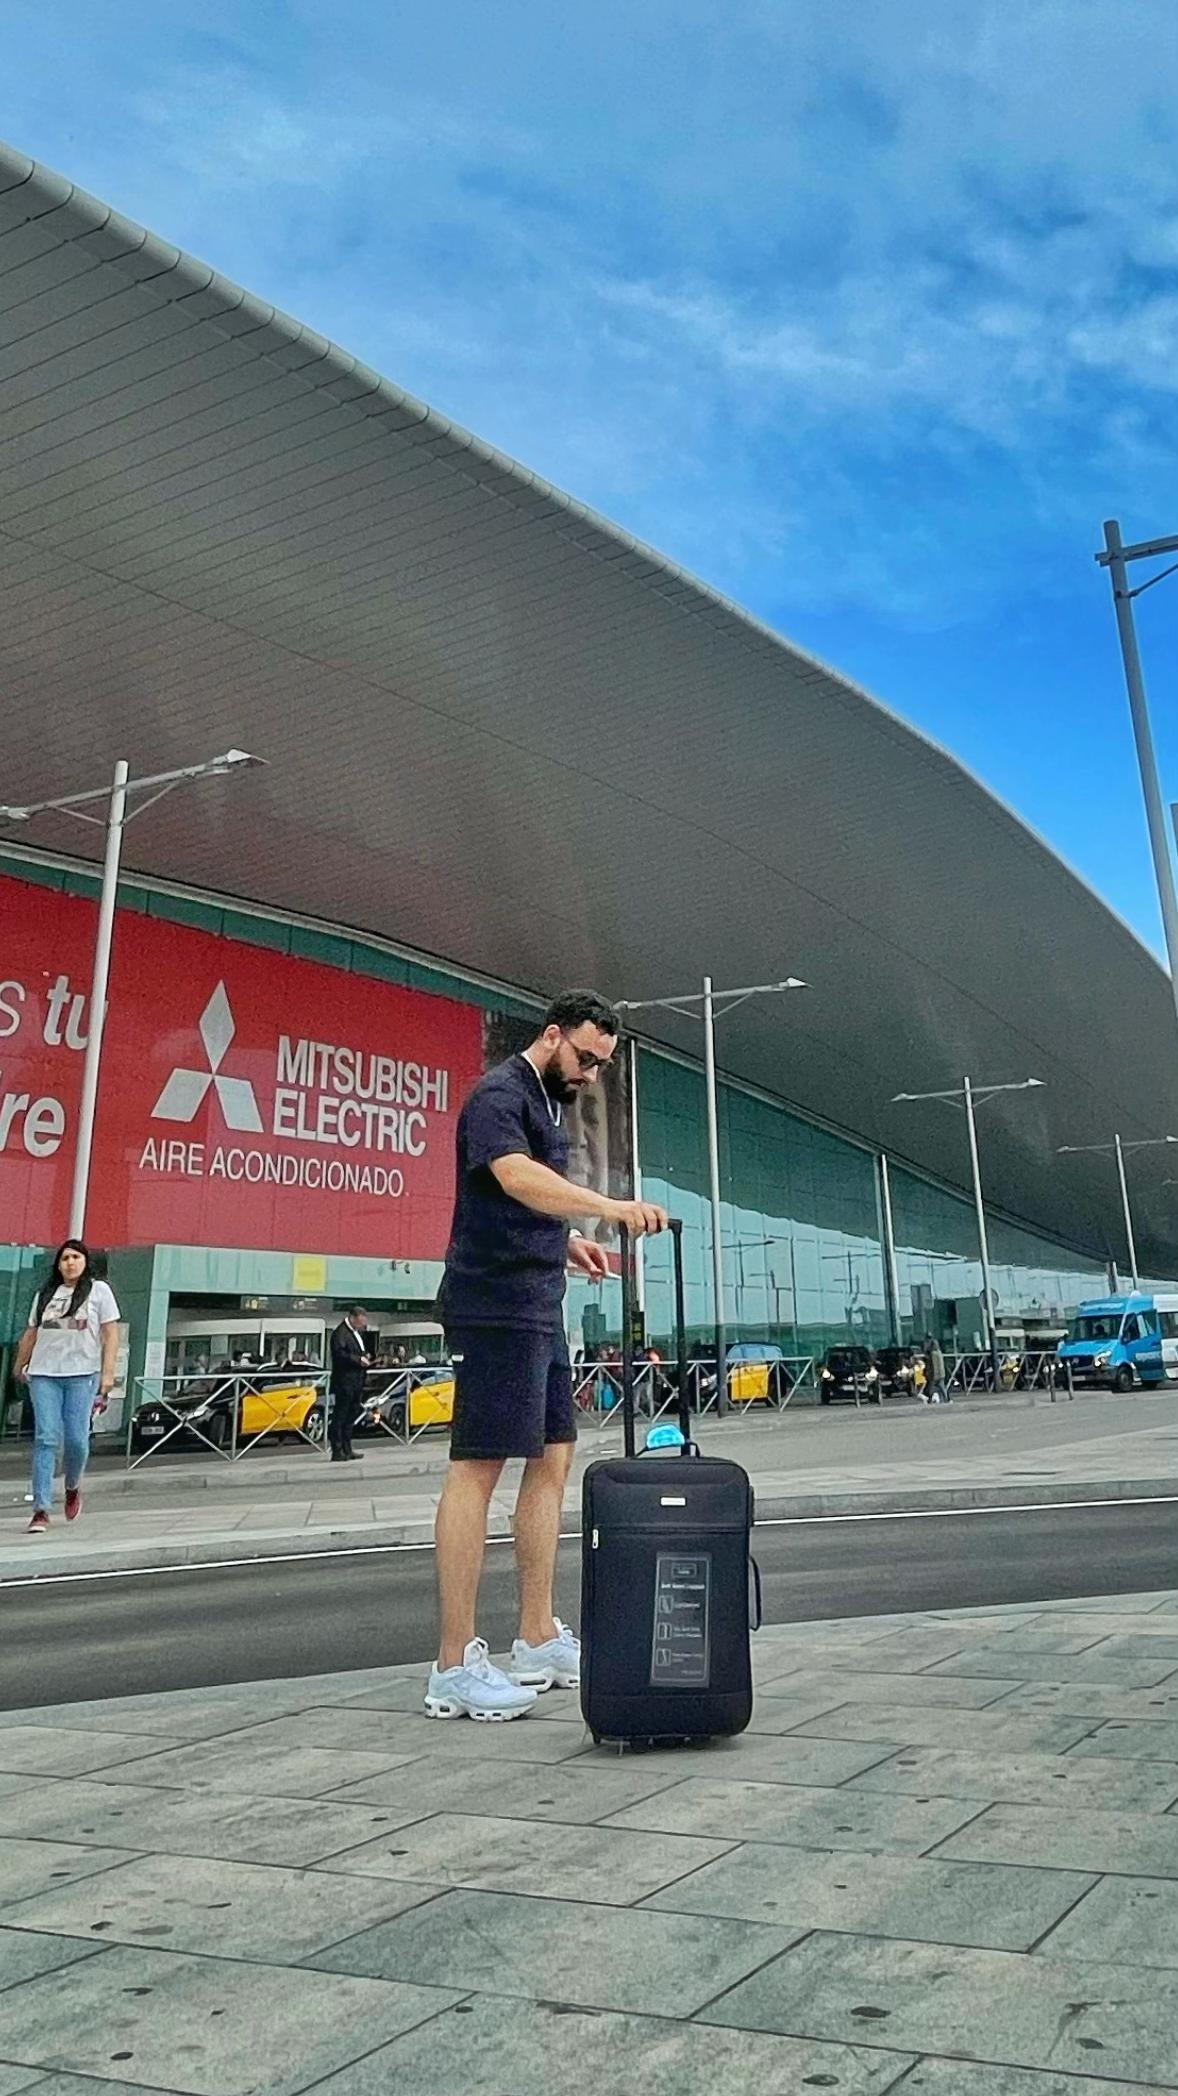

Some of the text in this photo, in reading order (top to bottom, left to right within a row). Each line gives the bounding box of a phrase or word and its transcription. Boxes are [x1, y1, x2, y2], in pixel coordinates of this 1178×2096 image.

[276, 1035, 448, 1112] MITSUBISHI
[273, 1088, 427, 1157] ELECTRIC
[139, 1138, 403, 1197] AIRE ACONDICIONADO
